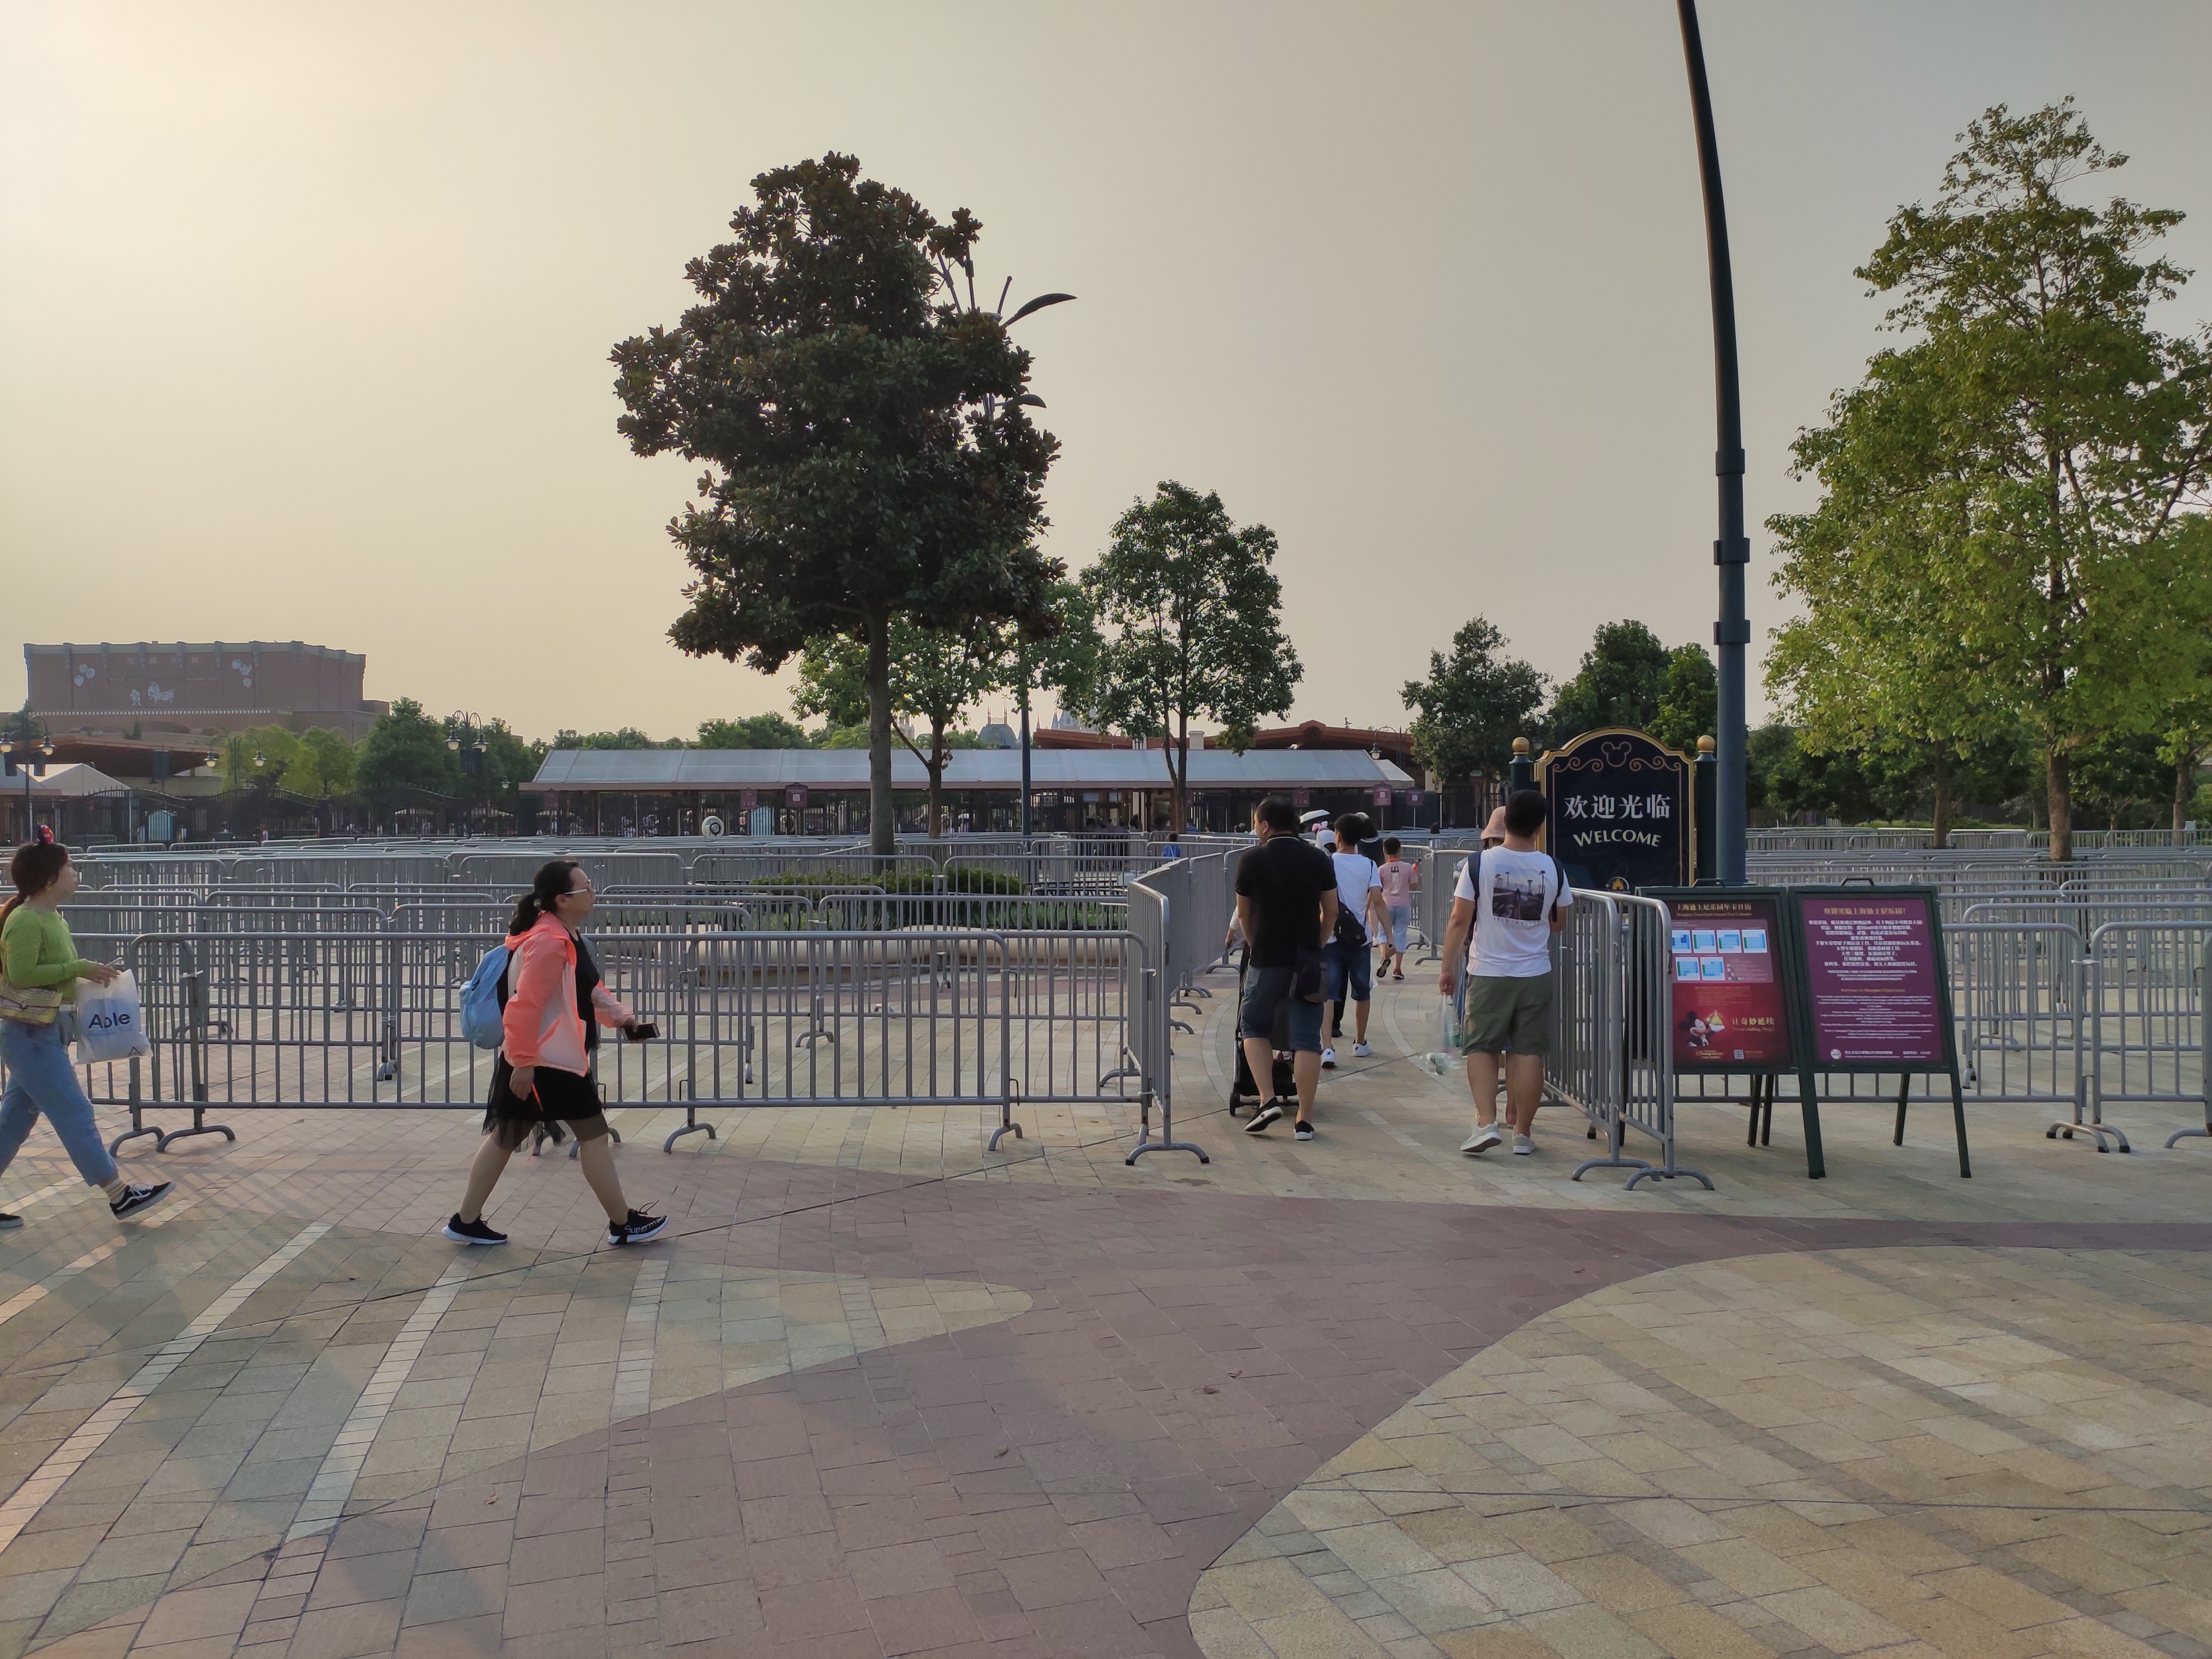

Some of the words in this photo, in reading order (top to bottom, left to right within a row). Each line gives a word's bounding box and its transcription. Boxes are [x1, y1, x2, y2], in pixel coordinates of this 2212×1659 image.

[1564, 794, 1671, 819] 欢迎光临
[1573, 830, 1661, 847] WELCOME
